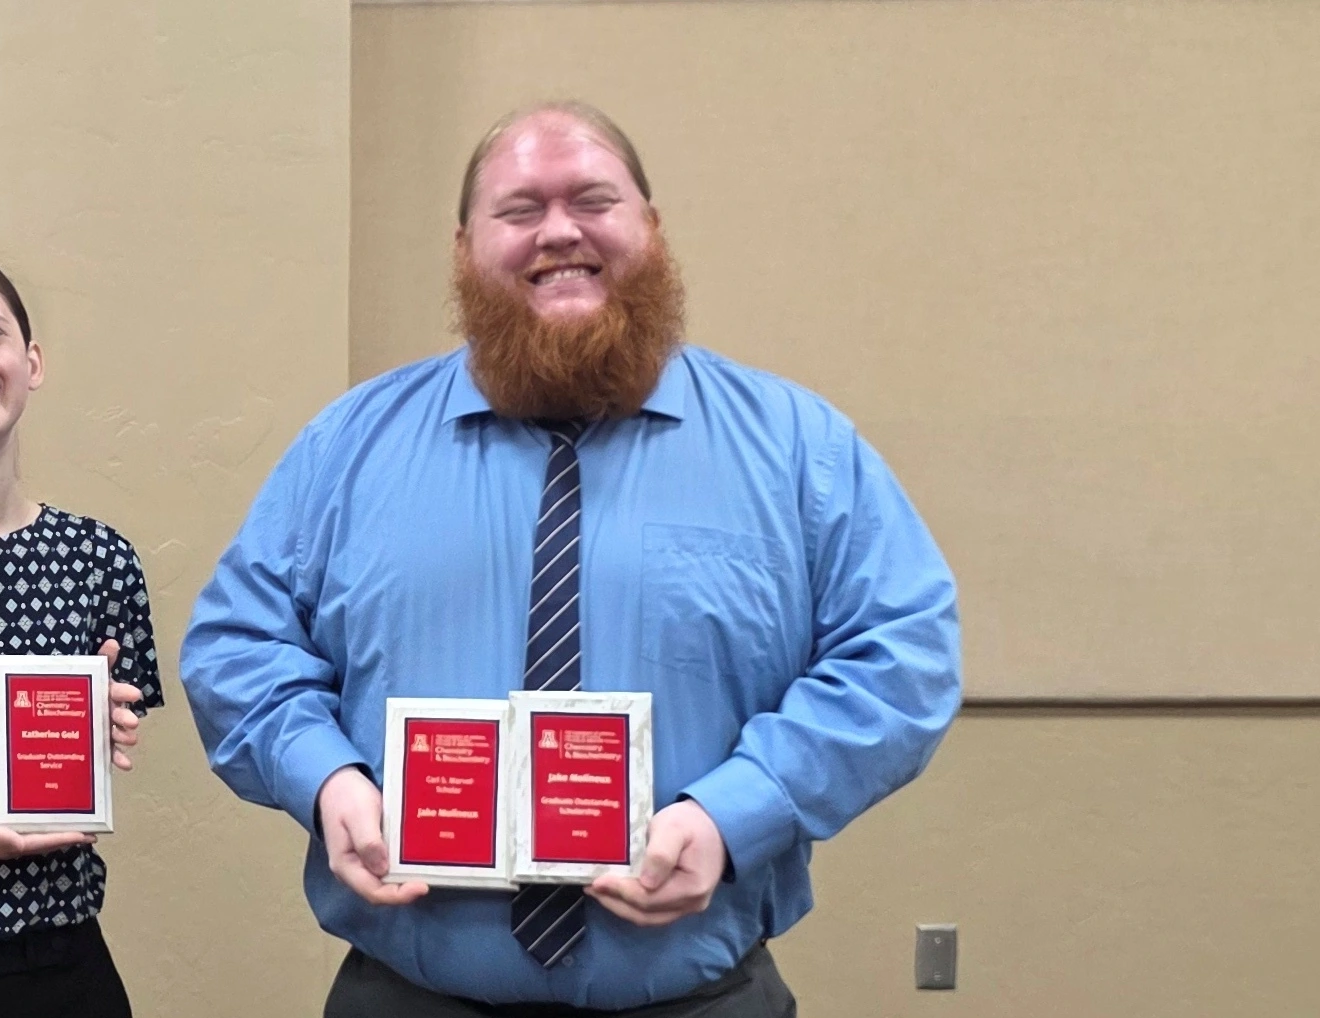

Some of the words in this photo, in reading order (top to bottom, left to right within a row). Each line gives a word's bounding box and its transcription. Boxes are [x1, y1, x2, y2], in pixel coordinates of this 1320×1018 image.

[44, 710, 85, 718] Biochemistry
[22, 731, 60, 739] Katherine
[61, 731, 79, 739] Gold
[435, 747, 473, 755] Chemistry
[564, 743, 603, 751] Chemistry
[47, 753, 85, 761] Outstanding
[443, 755, 490, 764] Biochemistry
[573, 752, 622, 761] Biochemistry
[548, 773, 568, 783] Jake
[541, 797, 573, 805] Graduate
[575, 797, 619, 808] Outstanding
[417, 808, 437, 818] Jake
